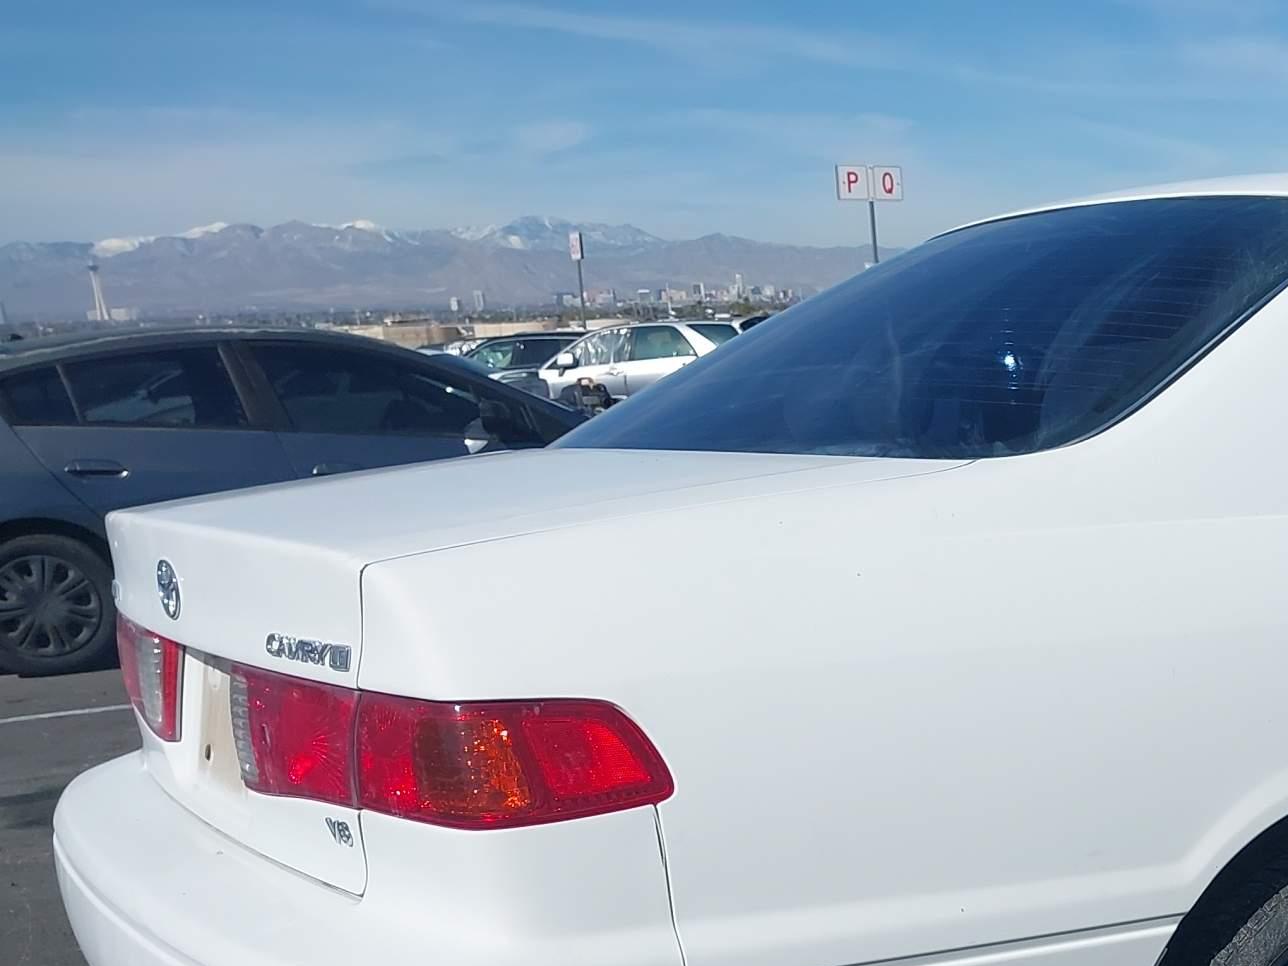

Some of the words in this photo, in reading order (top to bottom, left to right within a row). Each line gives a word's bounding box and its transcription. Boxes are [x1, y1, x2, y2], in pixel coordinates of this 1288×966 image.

[847, 171, 858, 193] P
[882, 171, 894, 194] Q
[266, 633, 332, 665] CAMRY
[325, 817, 353, 847] V6
